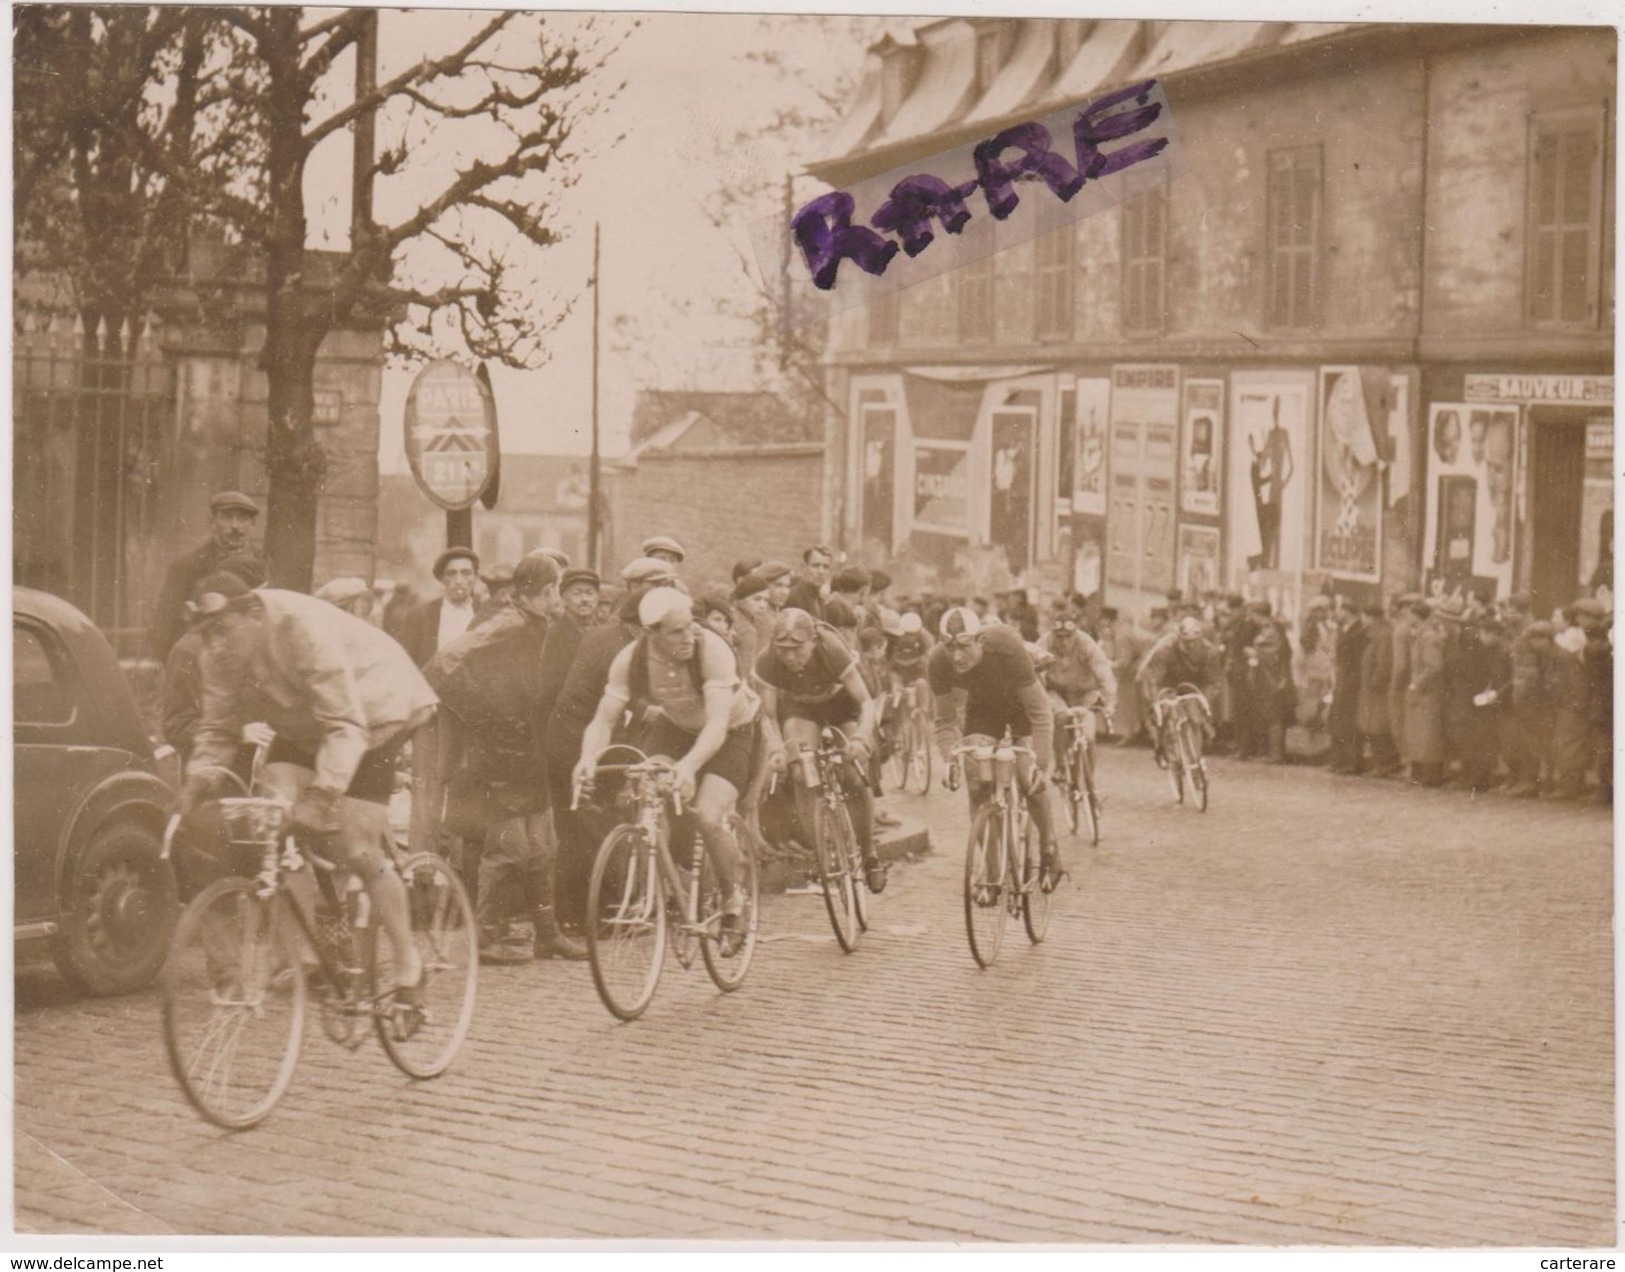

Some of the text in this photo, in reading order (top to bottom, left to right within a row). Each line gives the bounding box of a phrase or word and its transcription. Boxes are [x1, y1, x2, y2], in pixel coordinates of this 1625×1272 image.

[790, 79, 1169, 290] RARE
[1115, 369, 1176, 389] EMPIRE
[1498, 378, 1585, 399] SAUVEUR
[420, 386, 482, 409] PARIS
